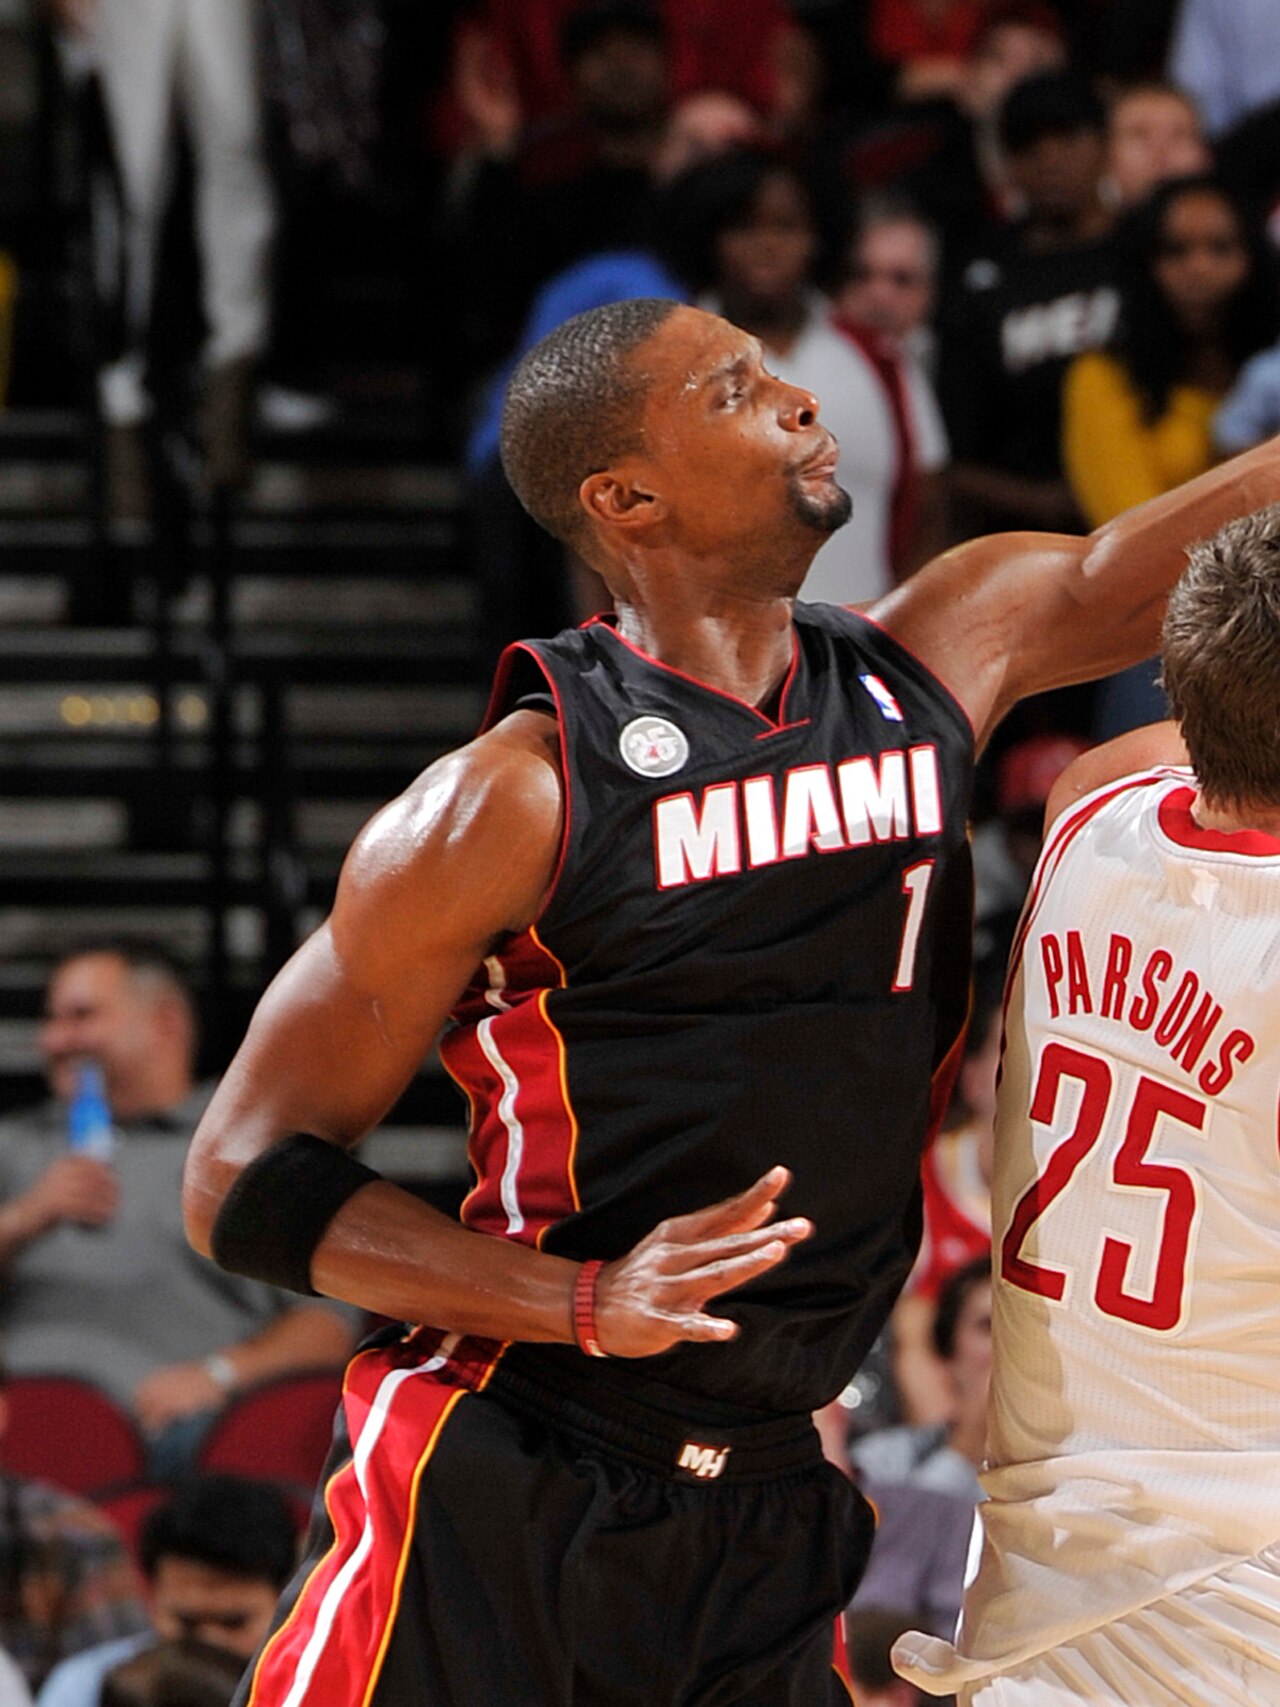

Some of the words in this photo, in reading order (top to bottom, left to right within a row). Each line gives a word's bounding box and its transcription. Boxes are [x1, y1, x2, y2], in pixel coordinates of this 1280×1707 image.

[653, 742, 943, 891] MIAMI
[890, 858, 936, 993] 1
[1040, 930, 1255, 1097] PARSONS
[1000, 1040, 1209, 1334] 25
